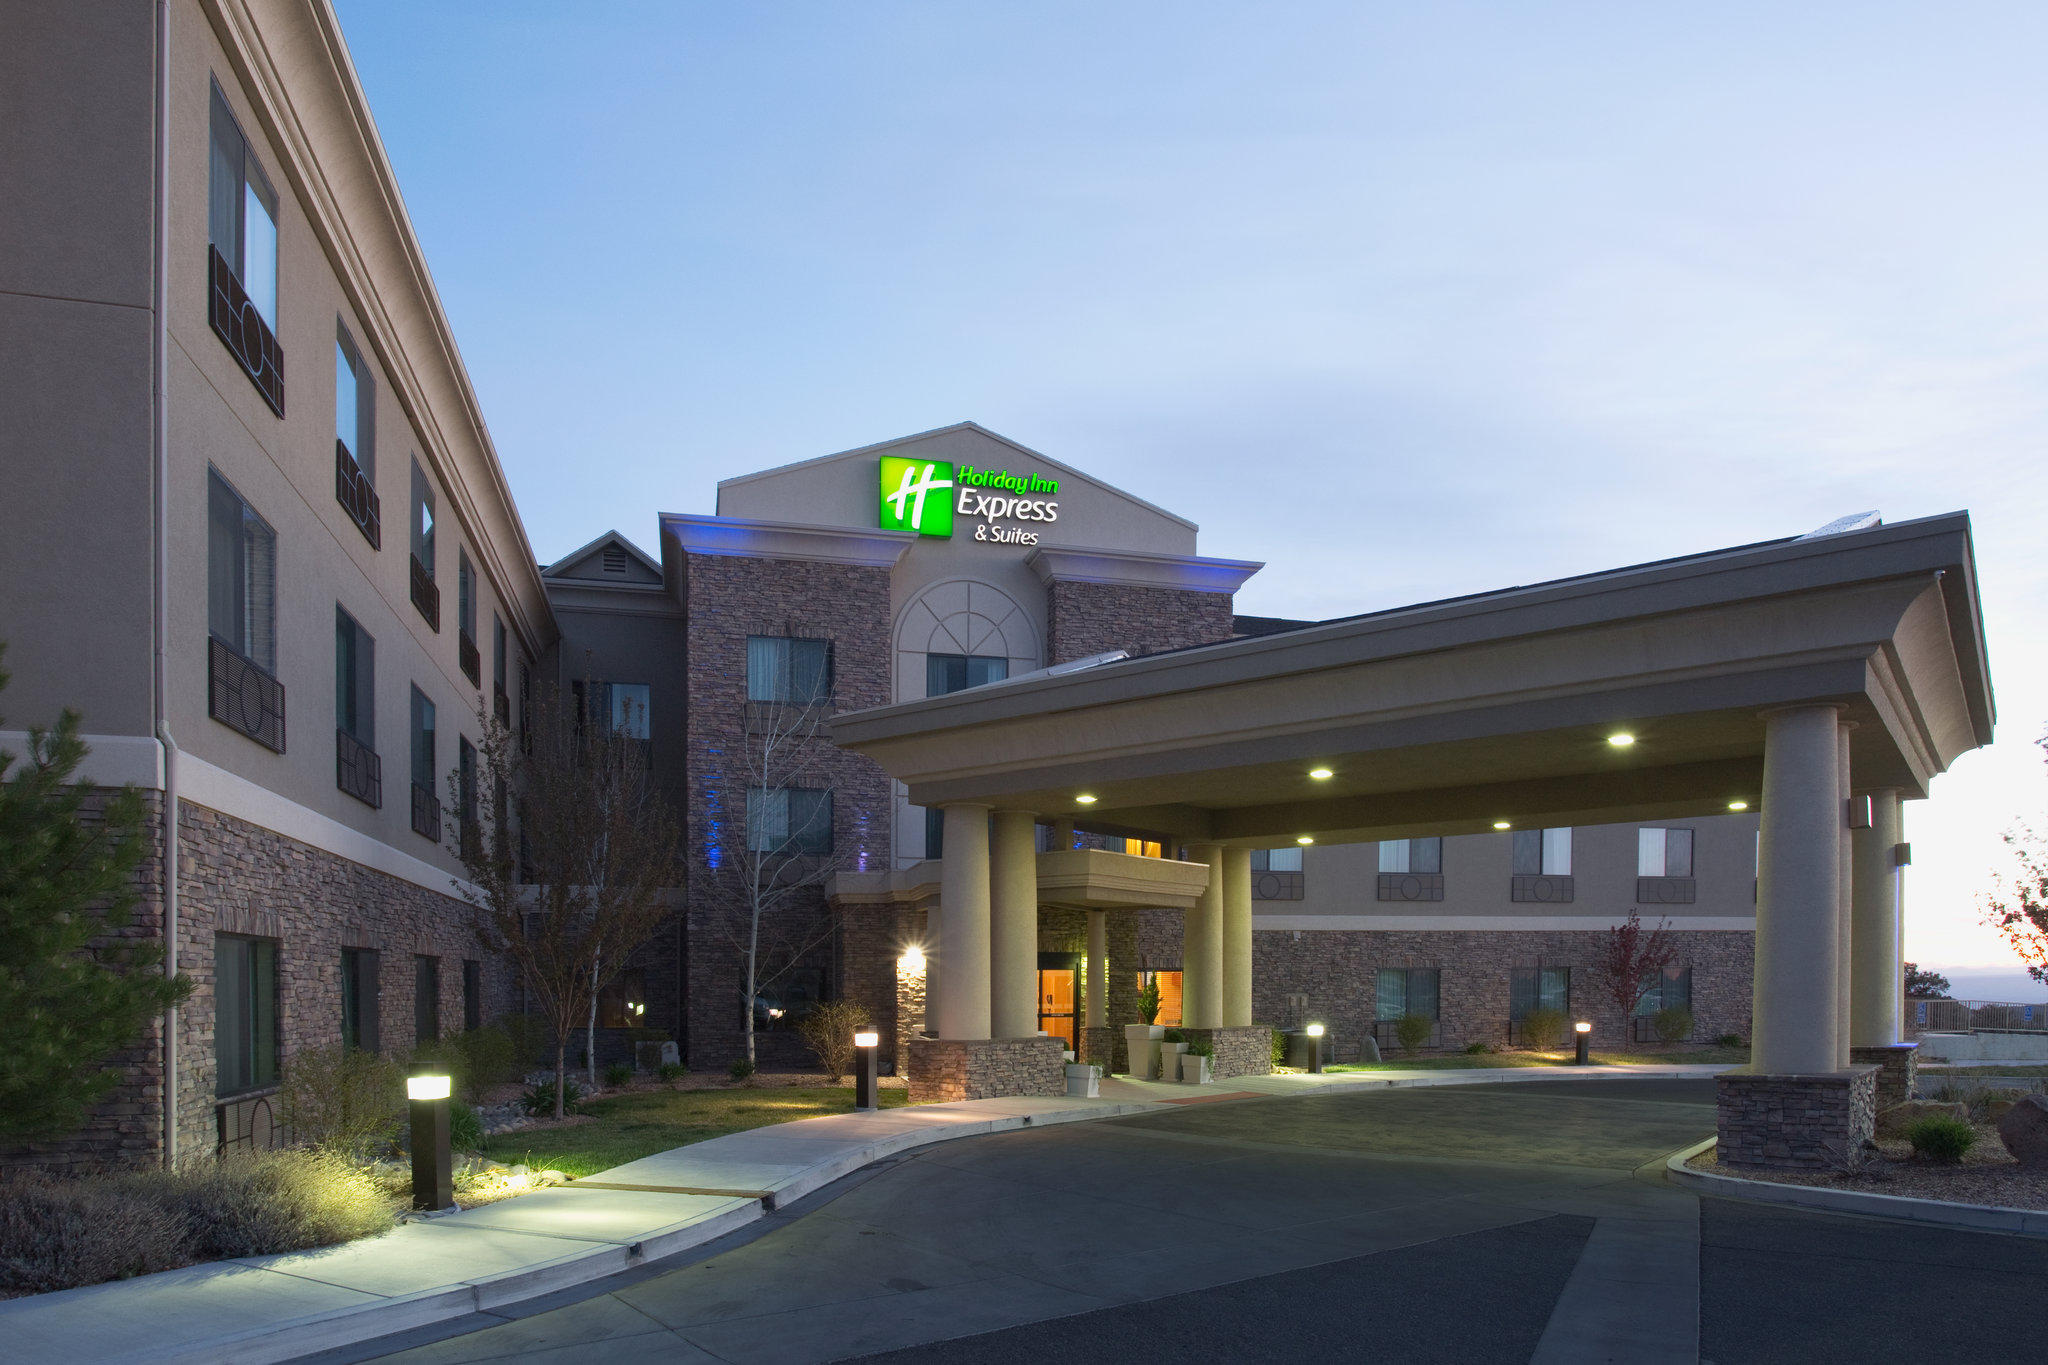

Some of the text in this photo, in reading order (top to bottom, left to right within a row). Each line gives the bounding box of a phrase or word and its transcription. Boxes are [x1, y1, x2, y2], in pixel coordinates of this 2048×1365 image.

[886, 464, 953, 529] H
[957, 465, 1059, 495] Holiday Inn
[957, 487, 1059, 524] Express
[974, 524, 1039, 546] & Suites
